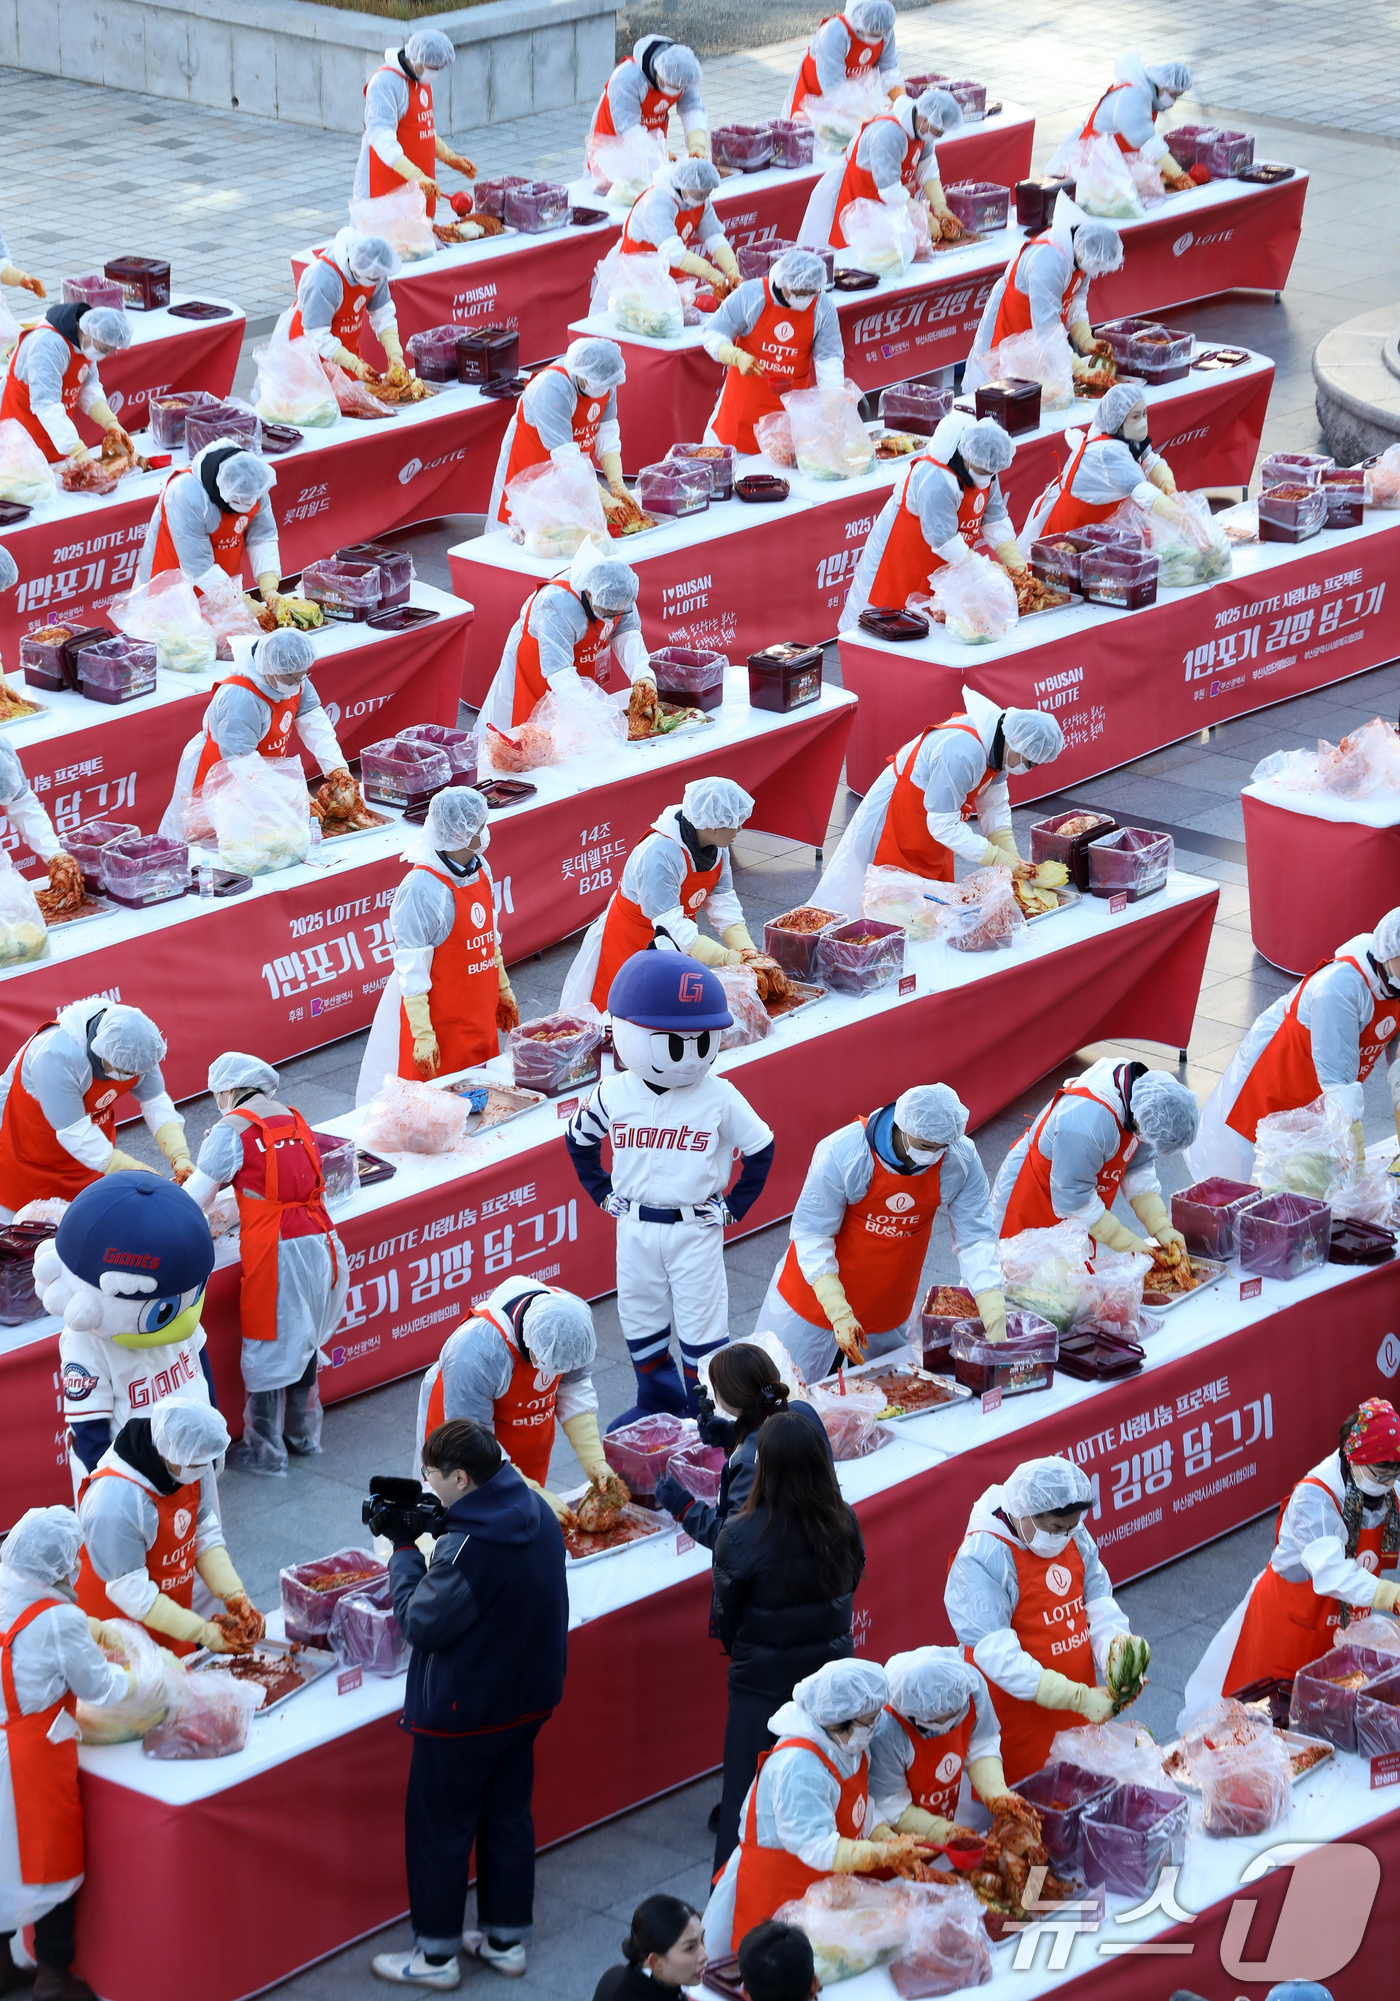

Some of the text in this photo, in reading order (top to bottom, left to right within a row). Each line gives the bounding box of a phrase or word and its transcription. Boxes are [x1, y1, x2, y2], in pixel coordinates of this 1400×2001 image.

[1195, 229, 1234, 247] LOTTE
[466, 283, 497, 304] BUSAN
[464, 300, 495, 318] LOTTE
[762, 341, 799, 357] LOTTE
[759, 358, 795, 375] BUSAN
[1169, 426, 1210, 448] LOTTE
[423, 448, 468, 471] LOTTE
[297, 483, 329, 504] 22조
[283, 497, 331, 526] 롯데월드
[53, 542, 84, 565] 2025
[86, 530, 125, 555] LOTTE
[15, 558, 107, 614] 1만포기
[676, 574, 712, 599] BUSAN
[1214, 568, 1363, 630] 2025 LOTTE 사랑나눔 프로젝트
[676, 594, 709, 615] LOTTE
[1182, 624, 1261, 682] 1만포기
[1318, 581, 1387, 636] 담그기
[1046, 666, 1084, 693] BUSAN
[1050, 685, 1080, 711] LOTTE
[54, 756, 104, 787] 프로젝트
[55, 771, 137, 833] 담그기
[579, 821, 611, 847] 14조
[560, 838, 627, 881] 롯데웰푸드
[578, 868, 613, 896] B2B
[289, 911, 324, 939] 2025
[326, 896, 371, 924] LOTTE
[466, 929, 494, 951] LOTTE
[261, 930, 365, 1001] 1만포기
[678, 972, 703, 1003] G
[288, 990, 354, 1023] 후원 부산광역시
[612, 1122, 712, 1152] Giants
[369, 1228, 418, 1264] LOTTE
[420, 1207, 478, 1244] 사랑나눔
[480, 1182, 537, 1221] 프로젝트
[866, 1212, 921, 1226] LOTTE
[484, 1198, 578, 1275] 담그기
[103, 1247, 162, 1270] Giants
[346, 1301, 460, 1356] 부산광역시 부산시민단체협의회
[1066, 1376, 1231, 1466] LOTTE 사랑나눔 프로젝트
[1183, 1392, 1274, 1478] 담그기
[161, 1533, 197, 1567] LOTTE
[1043, 1595, 1084, 1626] LOTTE
